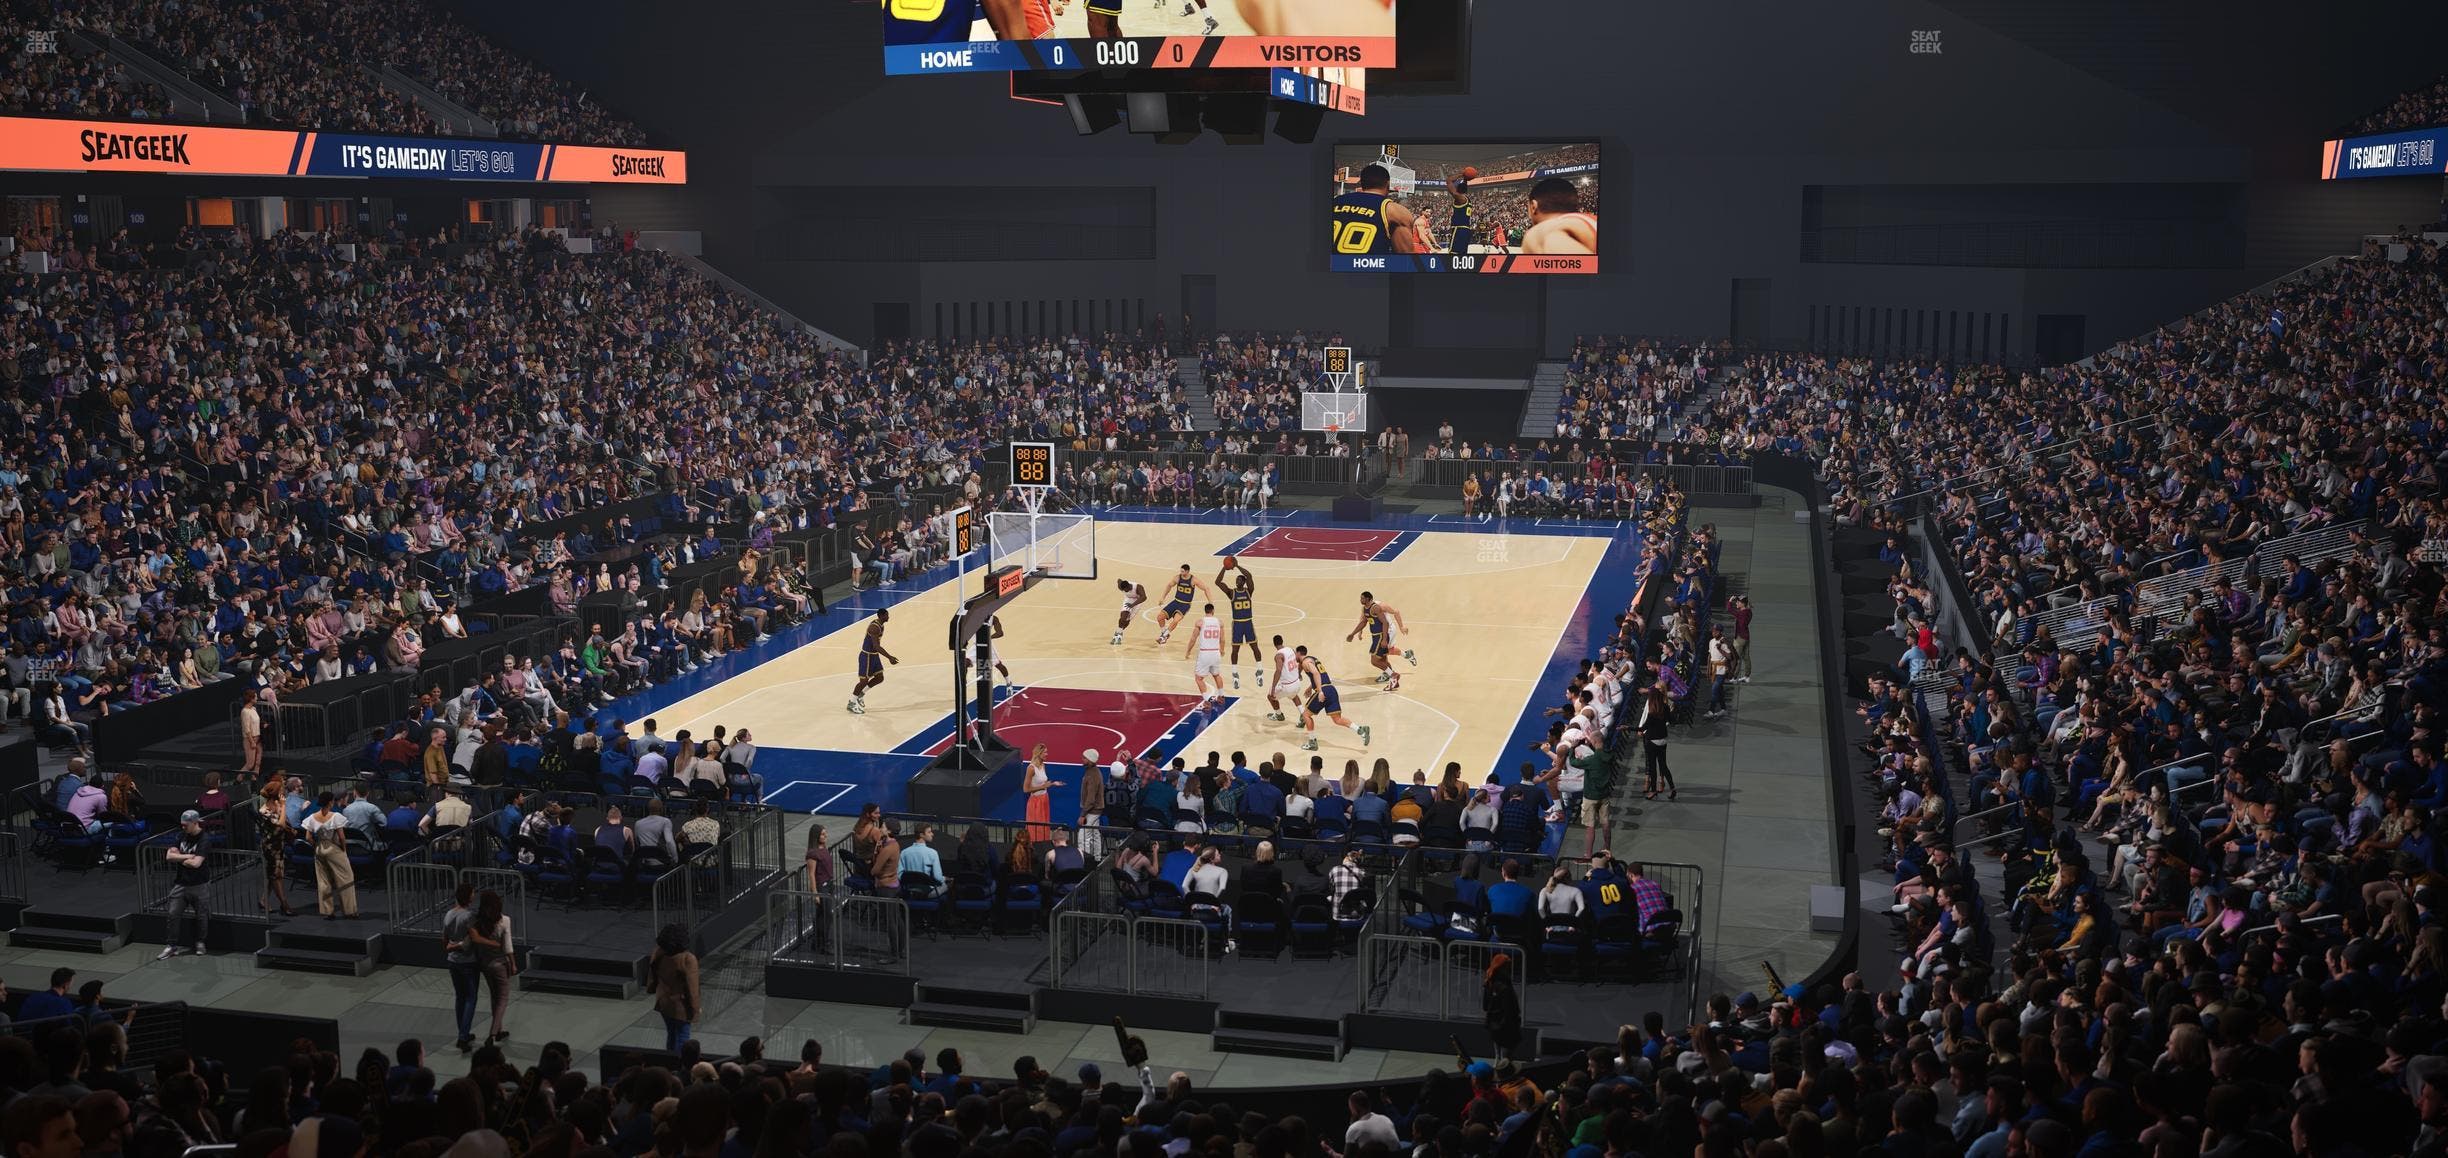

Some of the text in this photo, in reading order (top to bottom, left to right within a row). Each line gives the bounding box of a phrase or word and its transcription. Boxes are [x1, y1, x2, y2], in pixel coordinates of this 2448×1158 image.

[921, 41, 1361, 68] HOME 0 0:00 0 VISITORS
[1280, 77, 1295, 97] HOME
[80, 129, 191, 165] SEATGEEK
[2349, 139, 2435, 170] IT'S GAMEDAY LET'S GO!
[342, 145, 515, 173] IT'S GAMEDAY LET'S GO!
[611, 154, 666, 178] SEATGEEK
[130, 213, 145, 223] 109
[1353, 255, 1582, 270] HOME 0 0:00 0 VISITORS
[1330, 358, 1344, 371] 88
[1016, 448, 1047, 460] 88 88
[1020, 461, 1044, 481] 88
[959, 528, 969, 553] 88
[1001, 572, 1021, 592] SEATGEEK
[1234, 600, 1251, 610] 00
[1203, 629, 1219, 639] 00
[1600, 883, 1621, 905] 00
